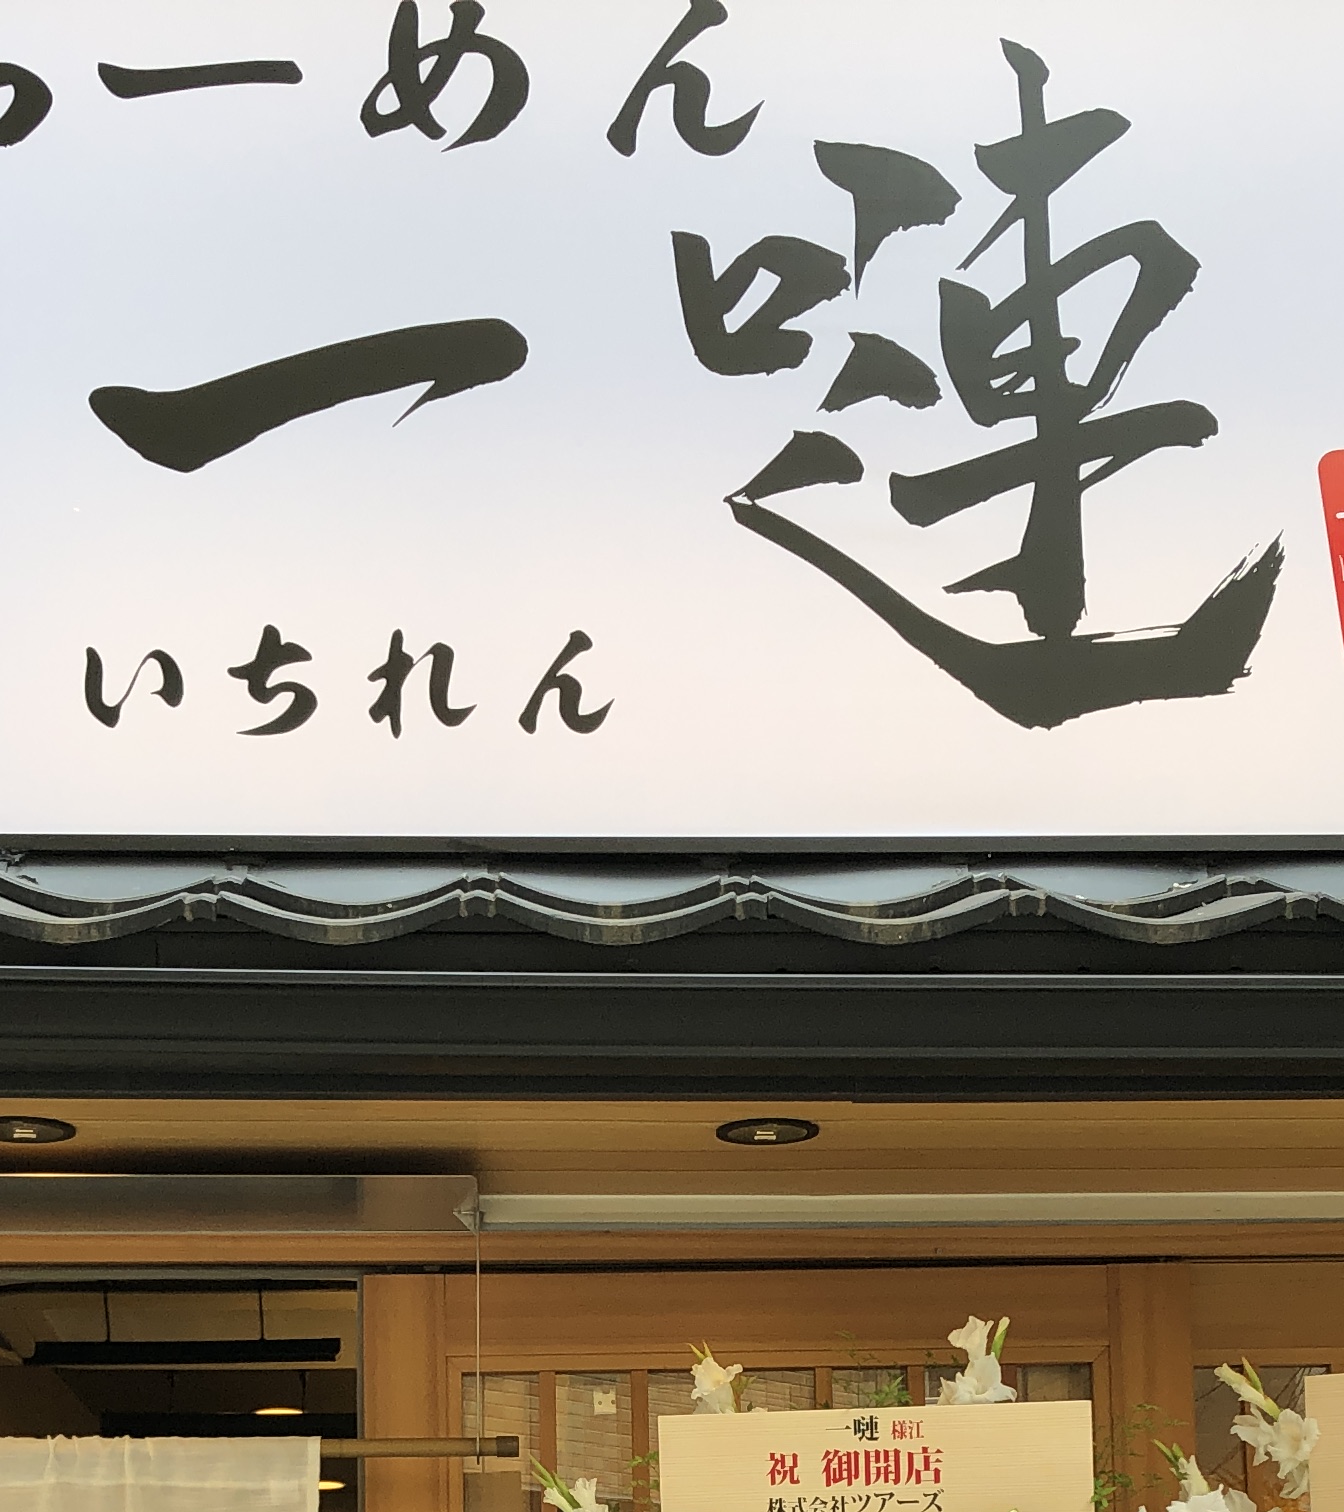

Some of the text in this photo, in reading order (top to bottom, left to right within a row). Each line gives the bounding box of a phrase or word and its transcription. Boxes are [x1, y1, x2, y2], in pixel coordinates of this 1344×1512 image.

[85, 625, 615, 738] いちれん
[890, 1419, 925, 1440] 様江
[765, 1446, 944, 1487] 祝 御開店
